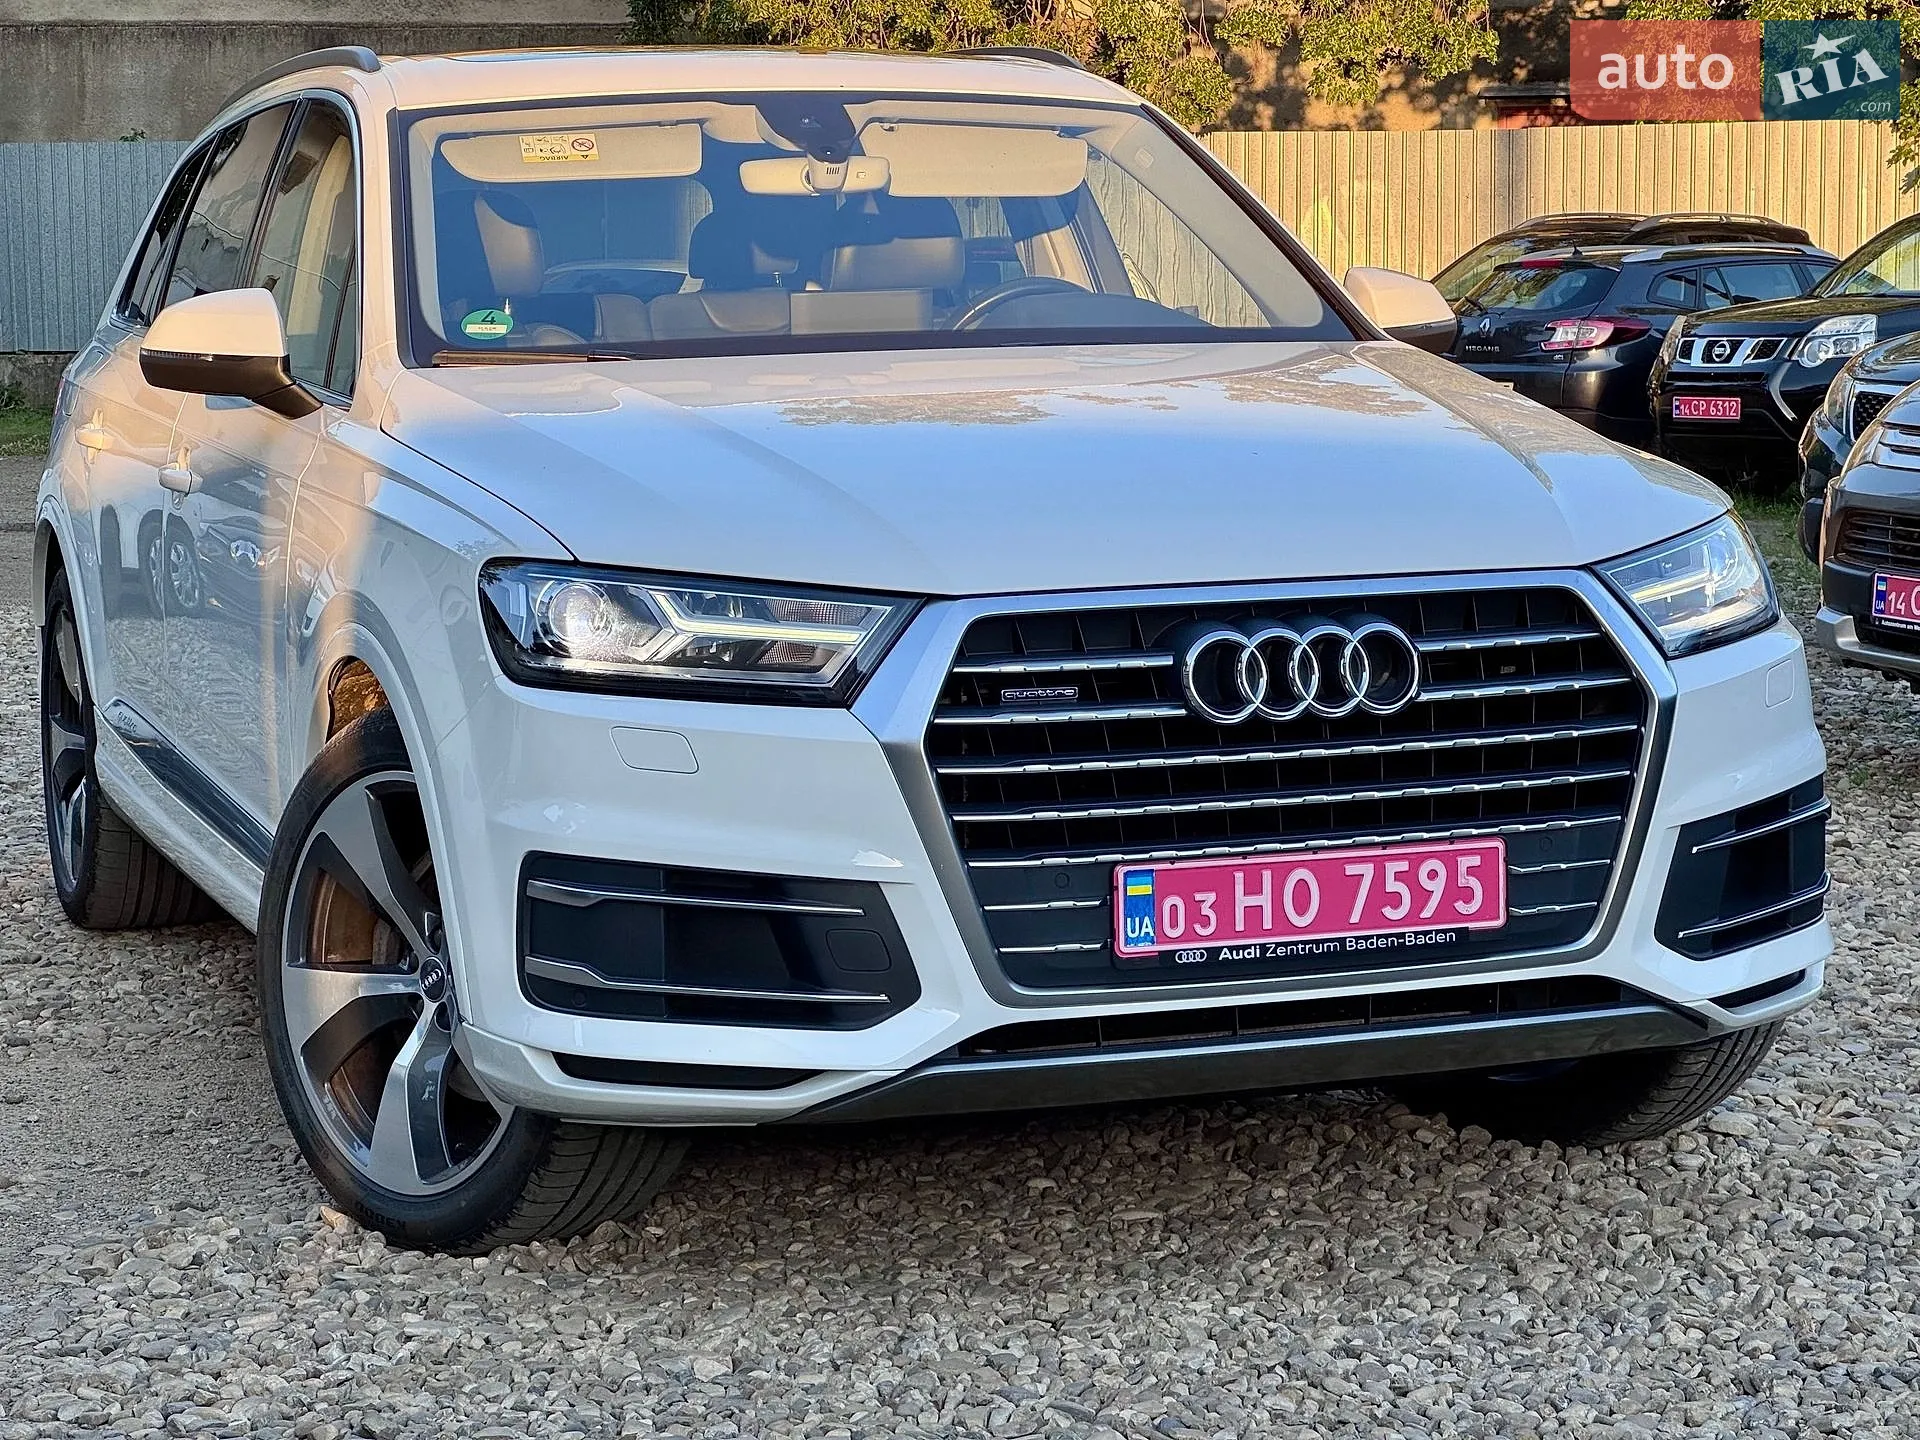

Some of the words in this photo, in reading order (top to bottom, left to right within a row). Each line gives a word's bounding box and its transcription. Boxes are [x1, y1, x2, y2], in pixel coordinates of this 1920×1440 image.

[481, 310, 497, 325] 4
[1680, 403, 1690, 416] 14
[1691, 401, 1707, 416] CP
[1710, 401, 1737, 416] 6312
[1875, 600, 1885, 611] UA
[1888, 591, 1906, 615] 14
[1005, 689, 1075, 700] quattro
[1161, 891, 1218, 939] 03
[1234, 868, 1321, 932] HO
[1344, 855, 1484, 924] 7595
[1126, 915, 1154, 939] UA
[1218, 945, 1261, 962] Audi
[1265, 939, 1341, 958] Zentrum
[1346, 930, 1456, 951] Baden-Baden
